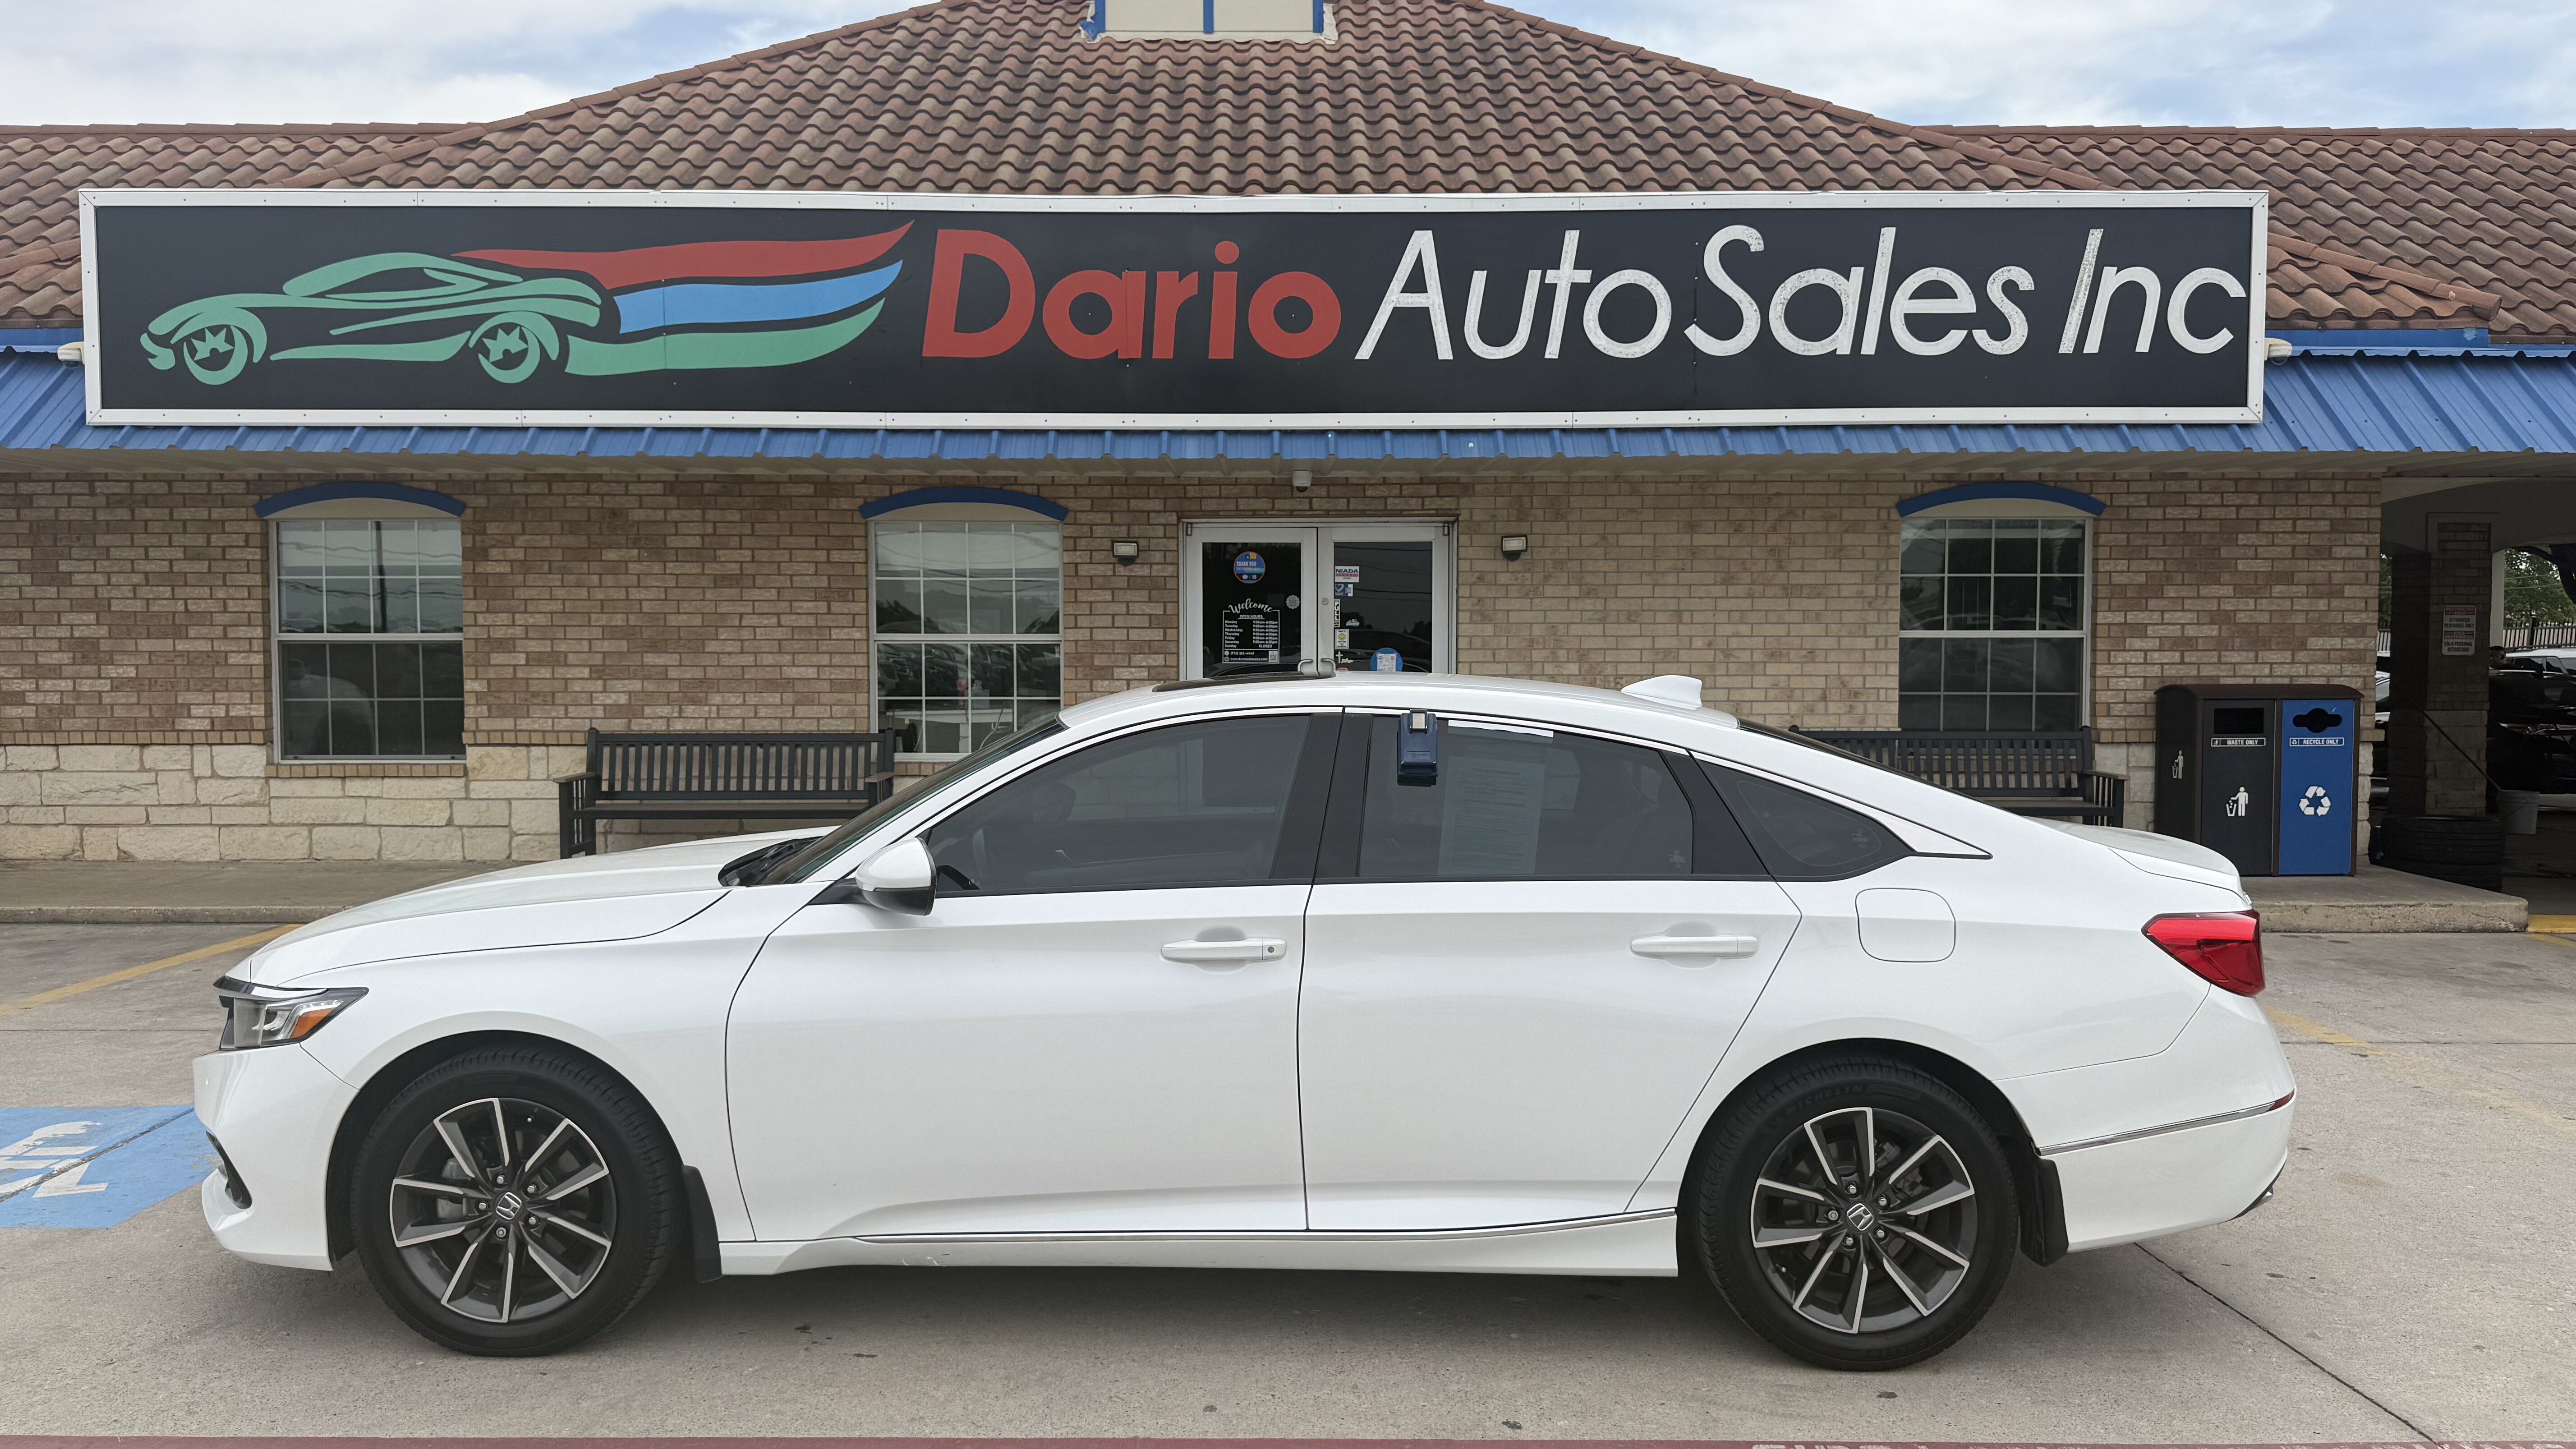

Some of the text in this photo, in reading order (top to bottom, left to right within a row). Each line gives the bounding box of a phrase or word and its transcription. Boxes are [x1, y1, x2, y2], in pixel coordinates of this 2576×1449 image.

[922, 224, 2246, 360] Dario Auto Sales Inc
[1228, 598, 1273, 613] Welcome
[1785, 1084, 1866, 1116] MICHELIN
